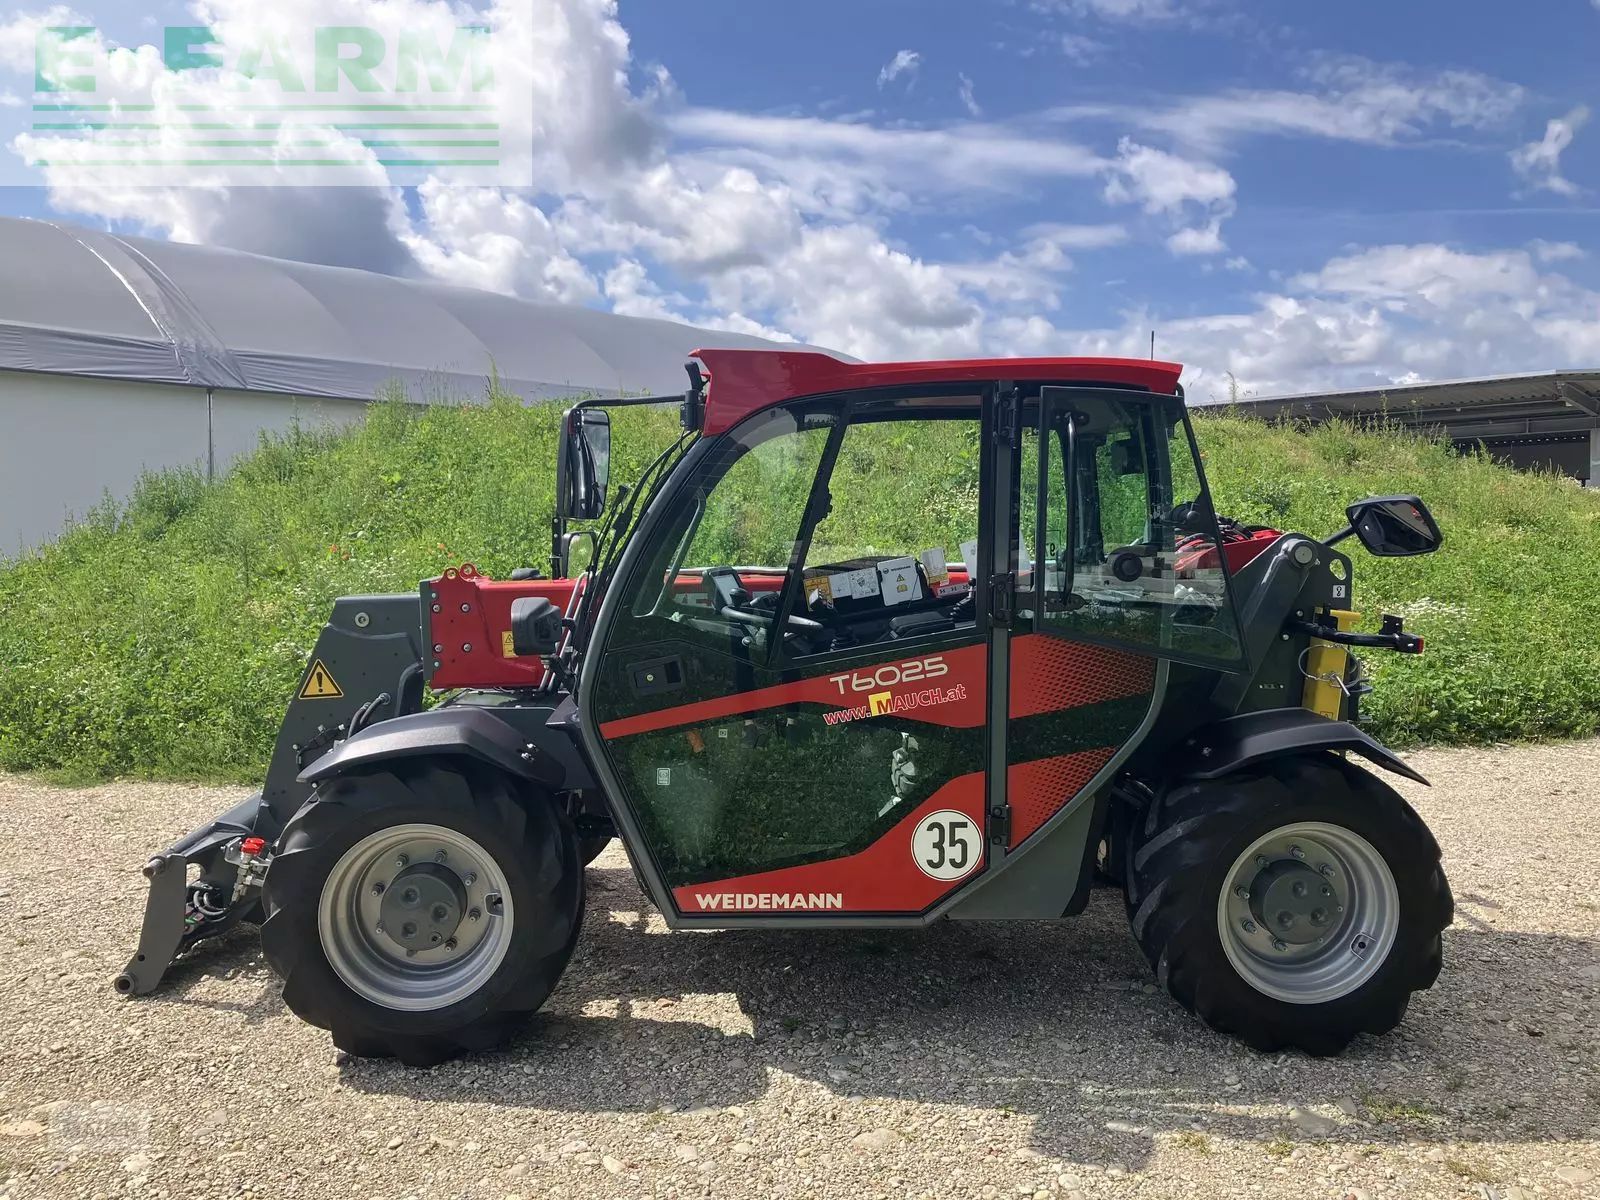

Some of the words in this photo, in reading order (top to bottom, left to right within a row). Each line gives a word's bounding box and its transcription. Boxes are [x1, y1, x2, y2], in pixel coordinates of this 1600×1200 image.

[829, 656, 949, 695] T6025
[926, 821, 968, 870] 35
[695, 893, 843, 909] WEIDEMANN
